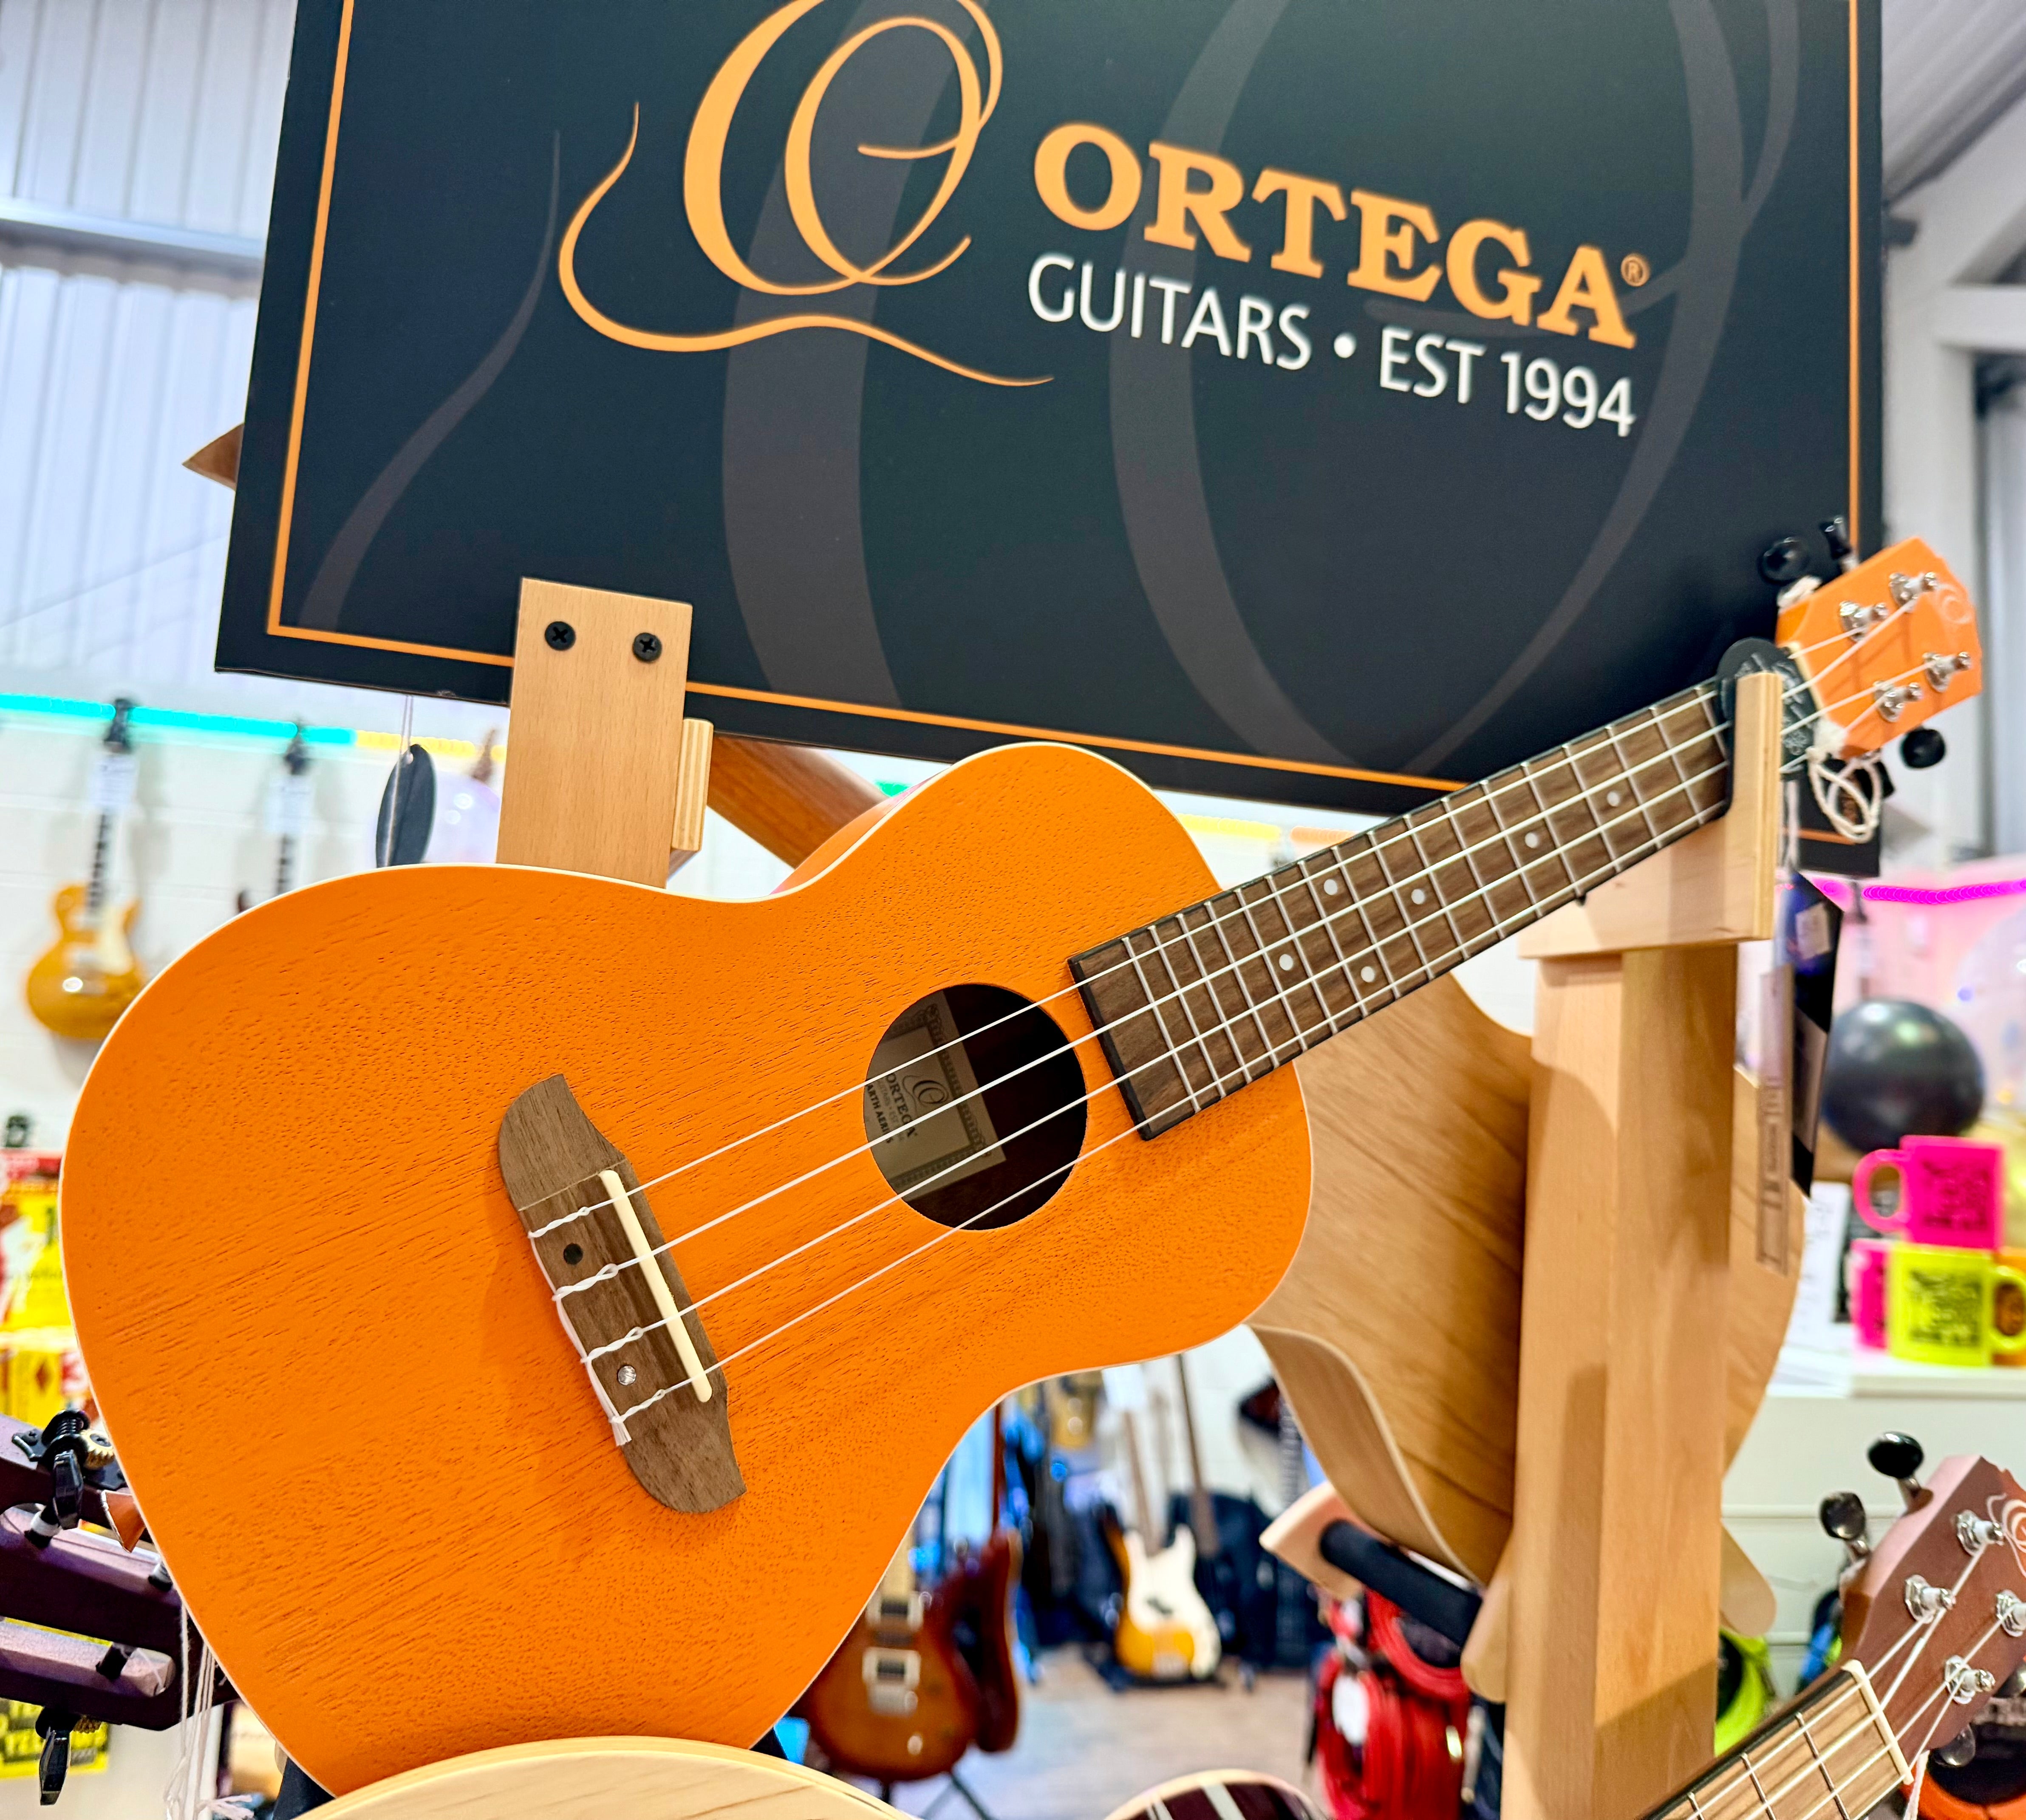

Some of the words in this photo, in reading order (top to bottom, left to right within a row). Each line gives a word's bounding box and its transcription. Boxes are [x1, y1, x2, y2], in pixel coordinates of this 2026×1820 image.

[1028, 253, 1311, 370] GUITARS
[1379, 326, 1485, 404] EST
[1500, 352, 1635, 437] 1994
